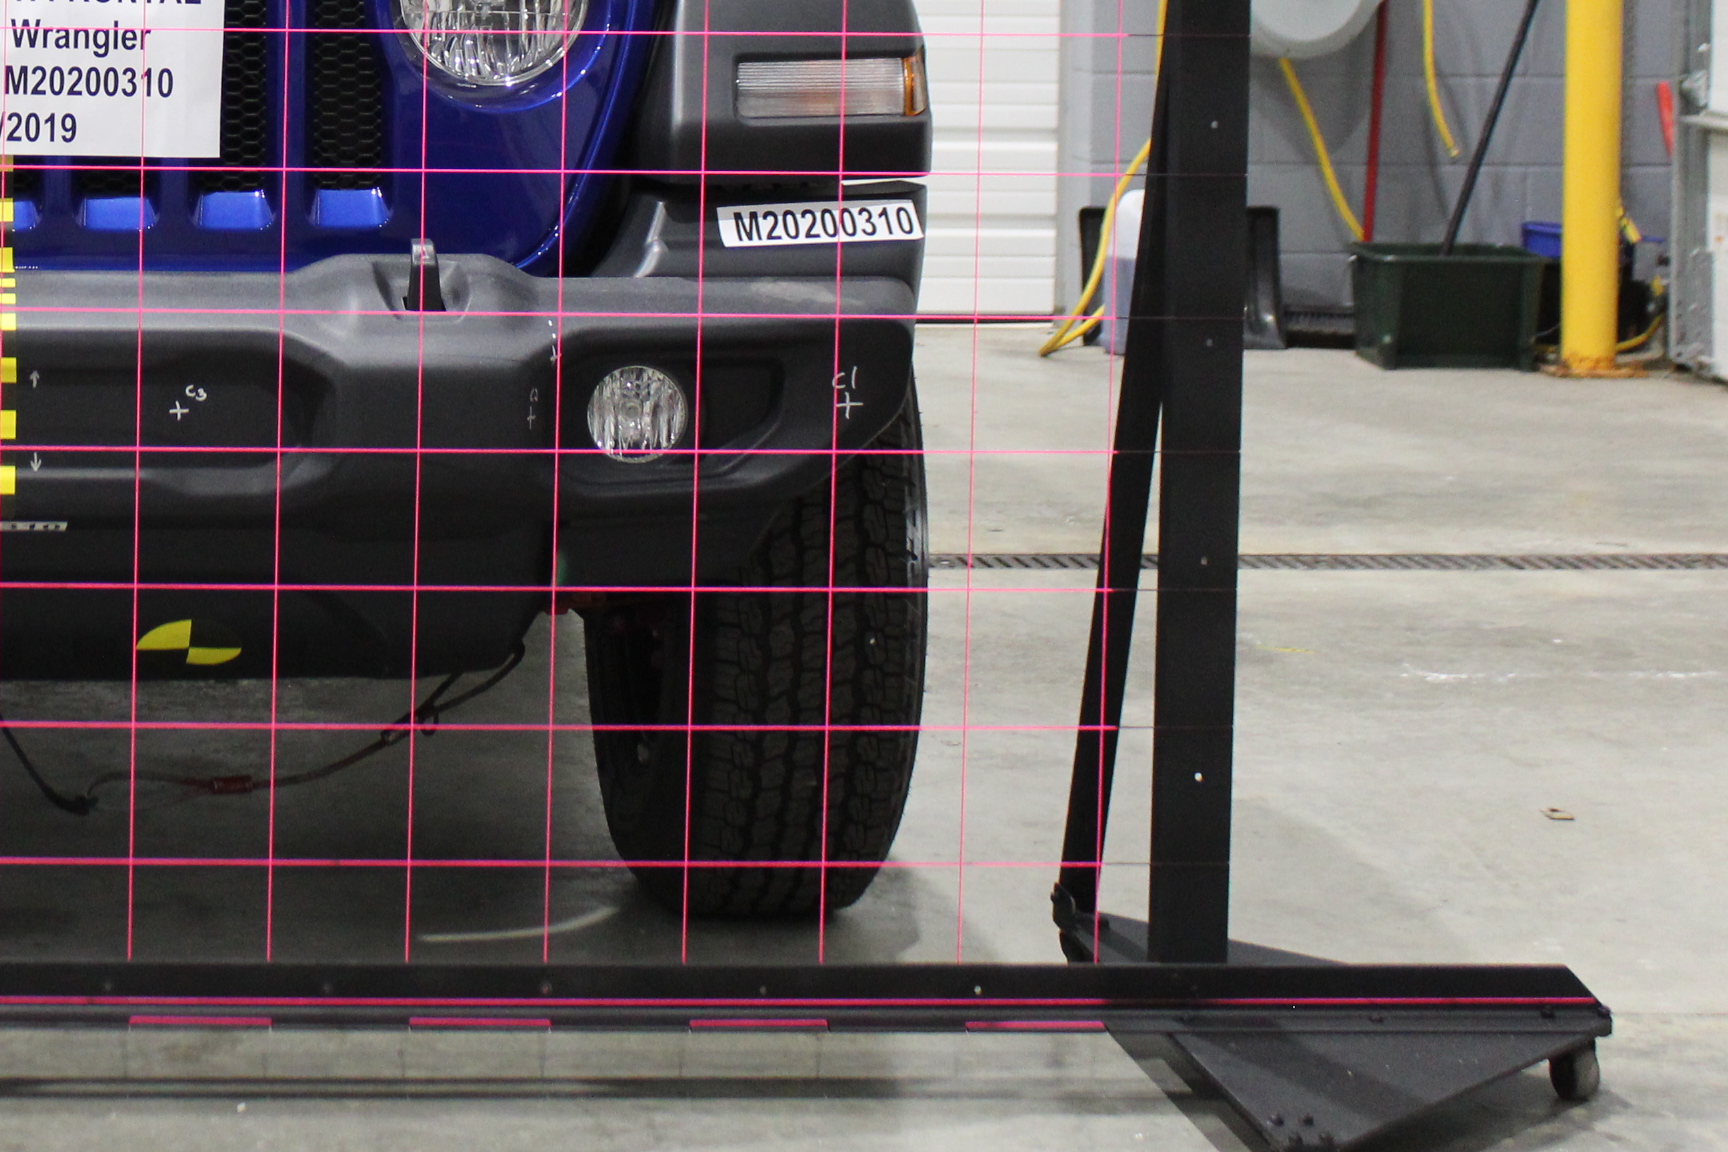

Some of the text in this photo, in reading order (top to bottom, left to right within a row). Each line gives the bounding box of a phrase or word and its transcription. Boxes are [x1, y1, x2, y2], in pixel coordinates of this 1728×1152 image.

[11, 19, 152, 58] Wrangler
[4, 65, 174, 98] M20200310
[733, 206, 914, 242] M20200310
